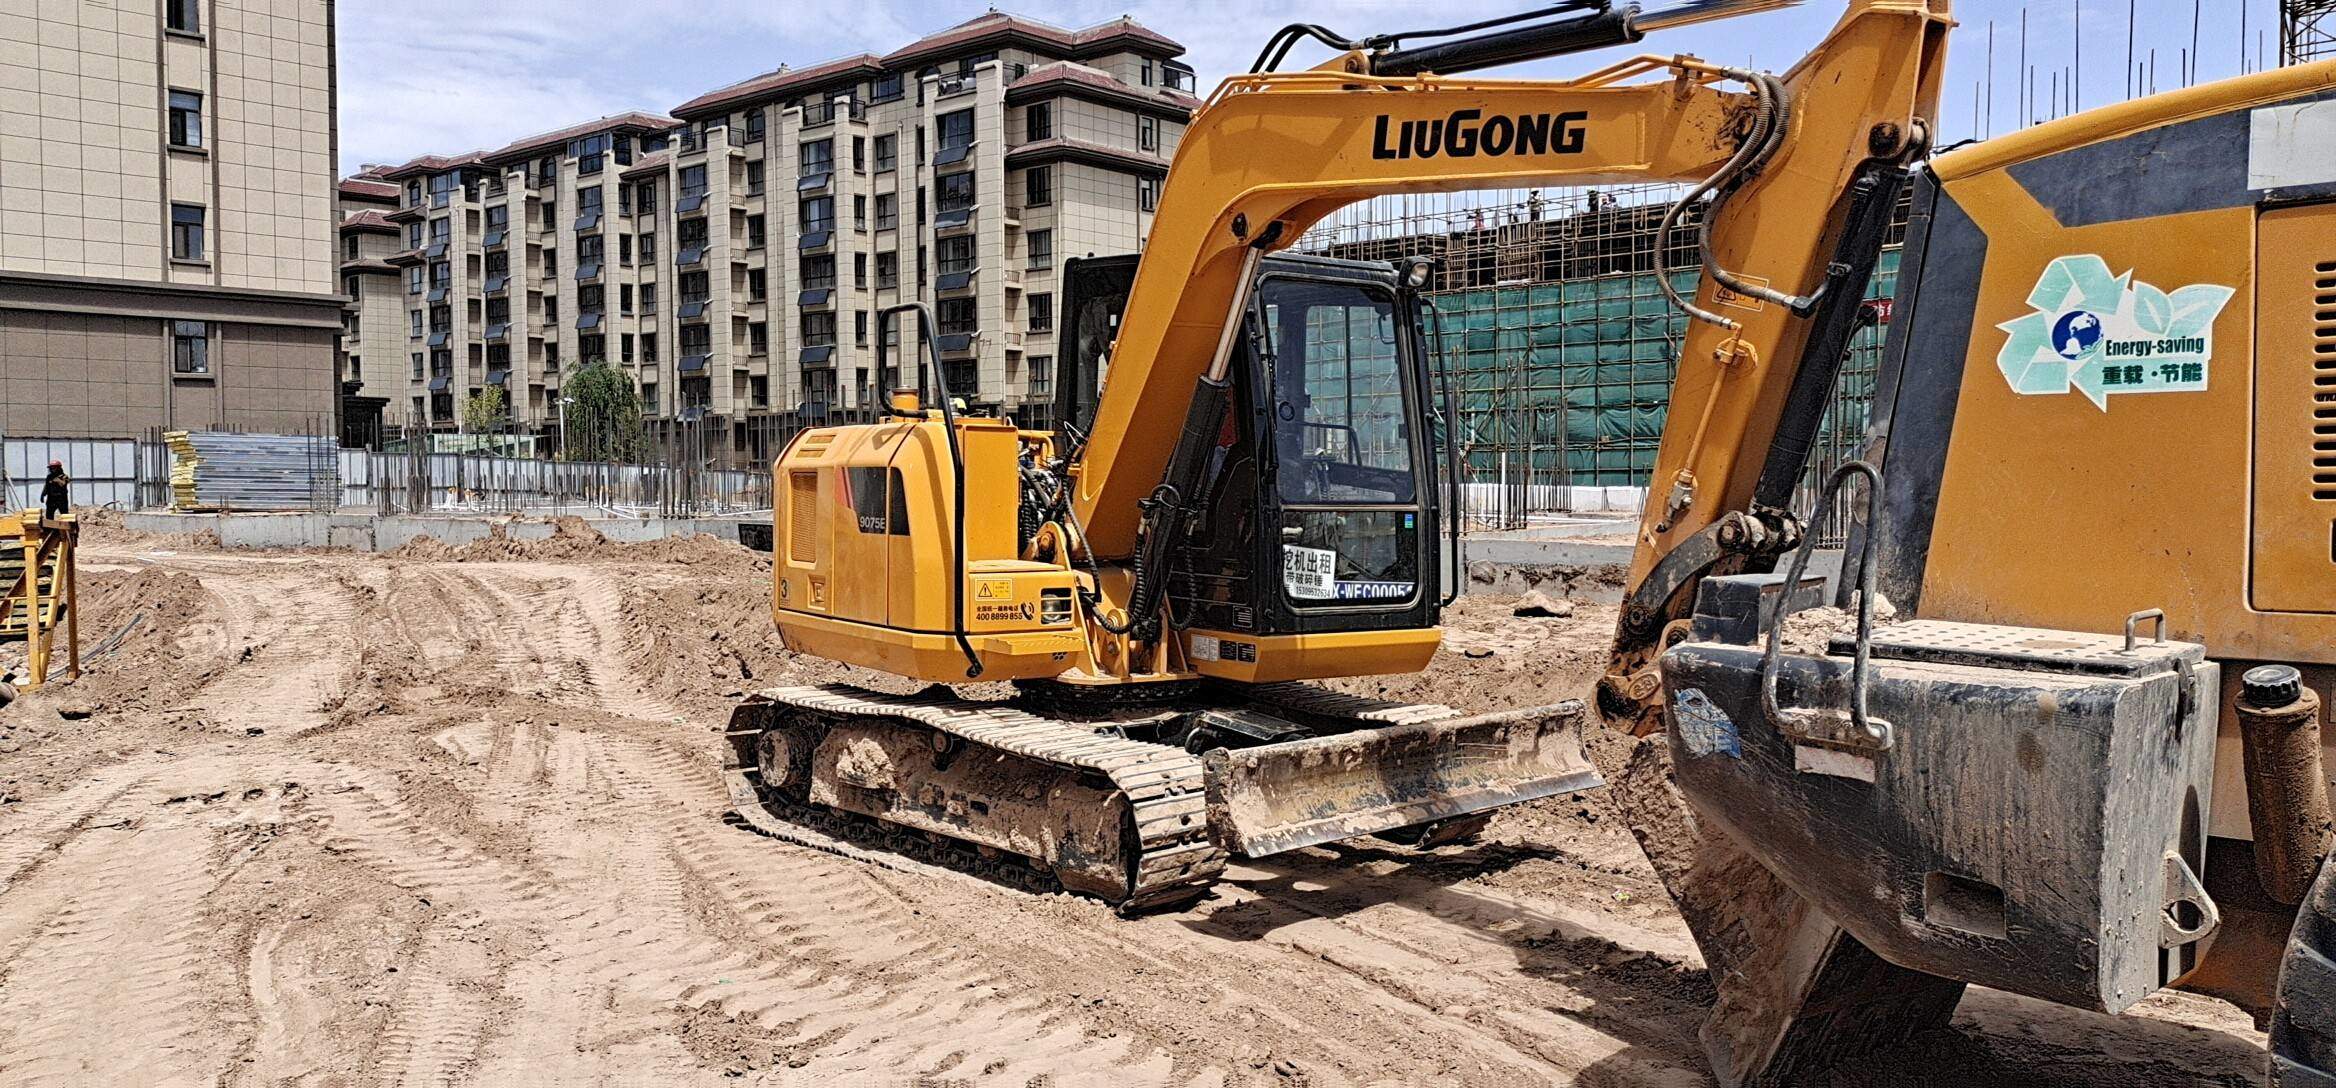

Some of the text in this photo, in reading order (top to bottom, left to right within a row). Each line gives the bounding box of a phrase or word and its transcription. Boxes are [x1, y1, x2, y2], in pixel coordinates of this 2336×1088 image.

[2105, 336, 2205, 357] Energy-saving
[860, 516, 886, 529] 9075E
[1284, 549, 1331, 574] 挖机出租
